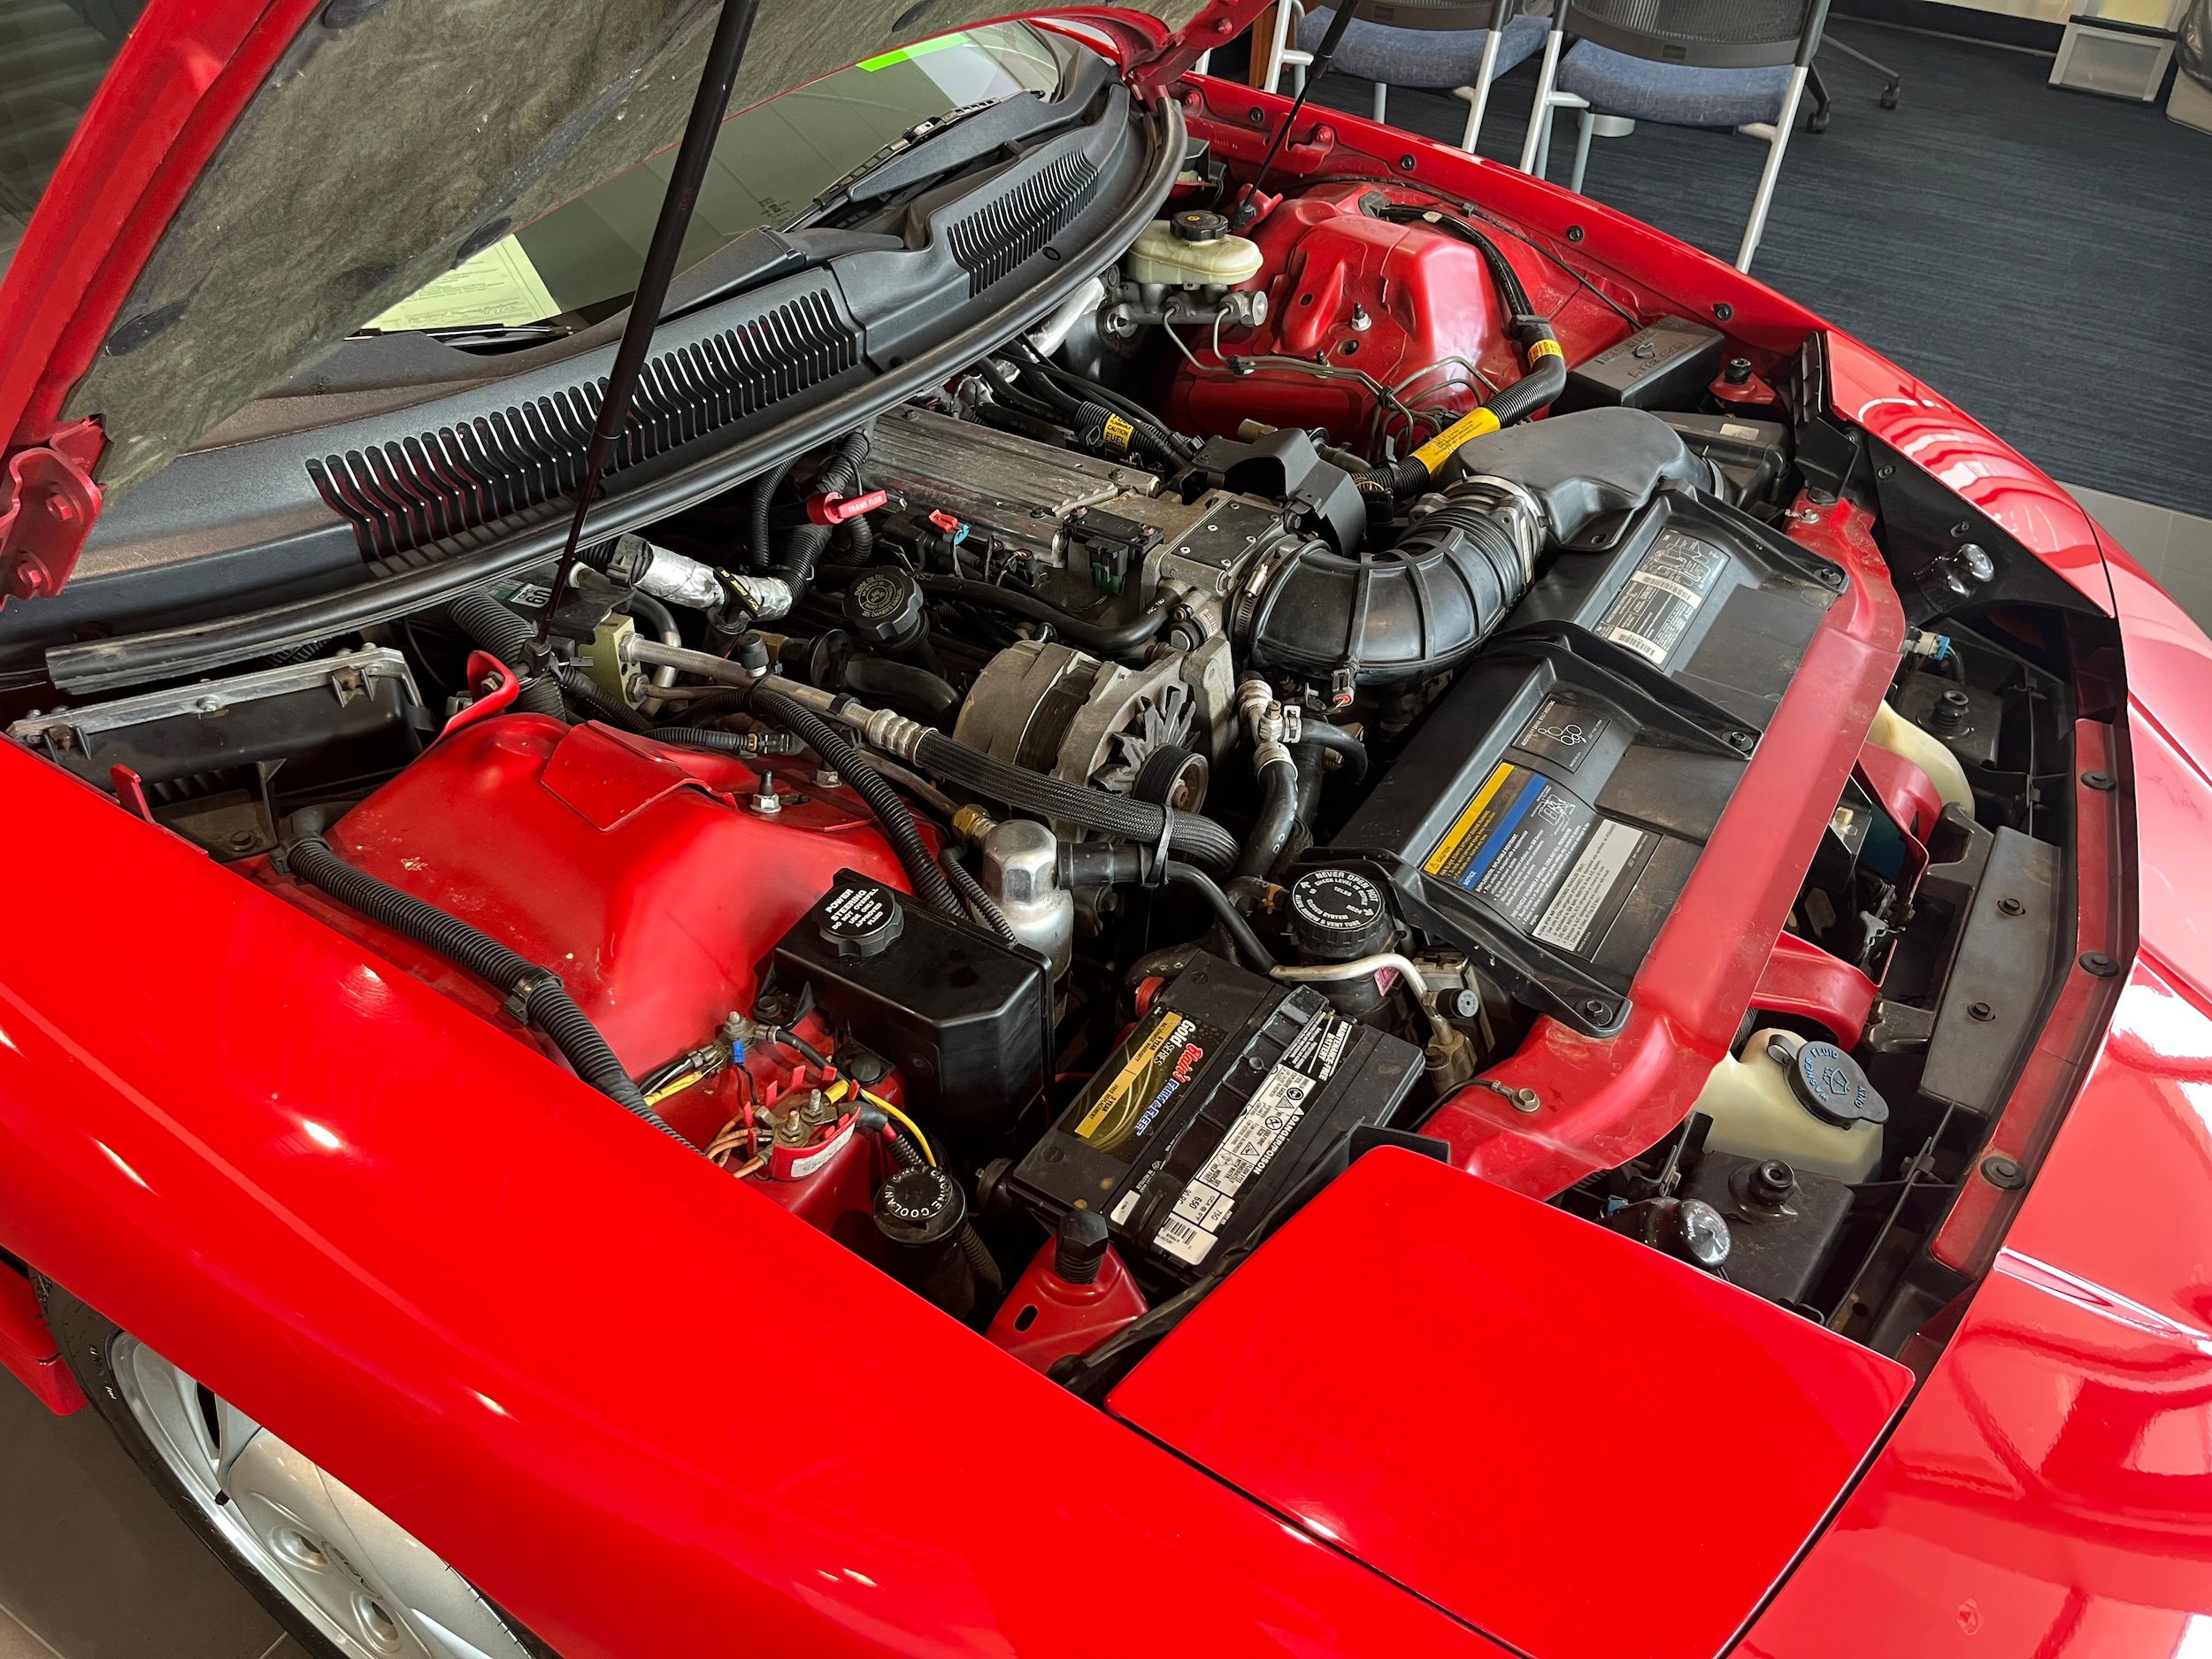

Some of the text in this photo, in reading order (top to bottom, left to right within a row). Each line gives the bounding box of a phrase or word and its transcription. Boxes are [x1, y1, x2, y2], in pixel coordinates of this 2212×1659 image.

[1105, 433, 1125, 445] FUEL
[1108, 425, 1129, 436] CAUTION
[848, 500, 867, 512] TRANS
[1436, 845, 1451, 862] CAUTION
[1347, 875, 1370, 888] OPEN
[1367, 889, 1379, 902] HOT
[1462, 870, 1476, 885] NOTICE
[825, 889, 854, 913] POWER
[831, 890, 867, 921] STEERING
[832, 888, 879, 930] DO NOT OVERFILL
[849, 900, 874, 924] USE ONLY
[1307, 899, 1323, 915] CLOSED
[856, 902, 882, 927] APPROVED
[867, 911, 883, 925] FLUID
[1149, 1039, 1160, 1050] YEAR
[1152, 1018, 1197, 1066] Gold SERIES
[1317, 1032, 1334, 1061] BATTERY
[1318, 1020, 1348, 1080] MAINTENANCE-FREE
[1171, 1041, 1205, 1085] Blain's
[1805, 1048, 1838, 1102] WASHER FLUID
[1087, 1083, 1118, 1119] FREE REPLACEMENT
[1155, 1078, 1179, 1103] FARM
[1854, 1085, 1866, 1108] ONLY
[1101, 1099, 1113, 1111] YEAR
[1150, 1099, 1162, 1110] &
[1133, 1105, 1159, 1136] FLEET
[1252, 1114, 1300, 1175] DANGER/POISON
[1209, 1163, 1218, 1171] HELP
[1228, 1161, 1247, 1183] IMMEDIATELY
[1233, 1158, 1241, 1168] WITH
[1207, 1169, 1221, 1184] MEDICAL
[1235, 1173, 1245, 1183] EYES
[931, 1170, 951, 1210] ENGINE
[1204, 1194, 1215, 1206] CCA
[885, 1186, 929, 1217] COOLANT
[1187, 1195, 1202, 1210] 650
[1210, 1208, 1222, 1221] 75G
